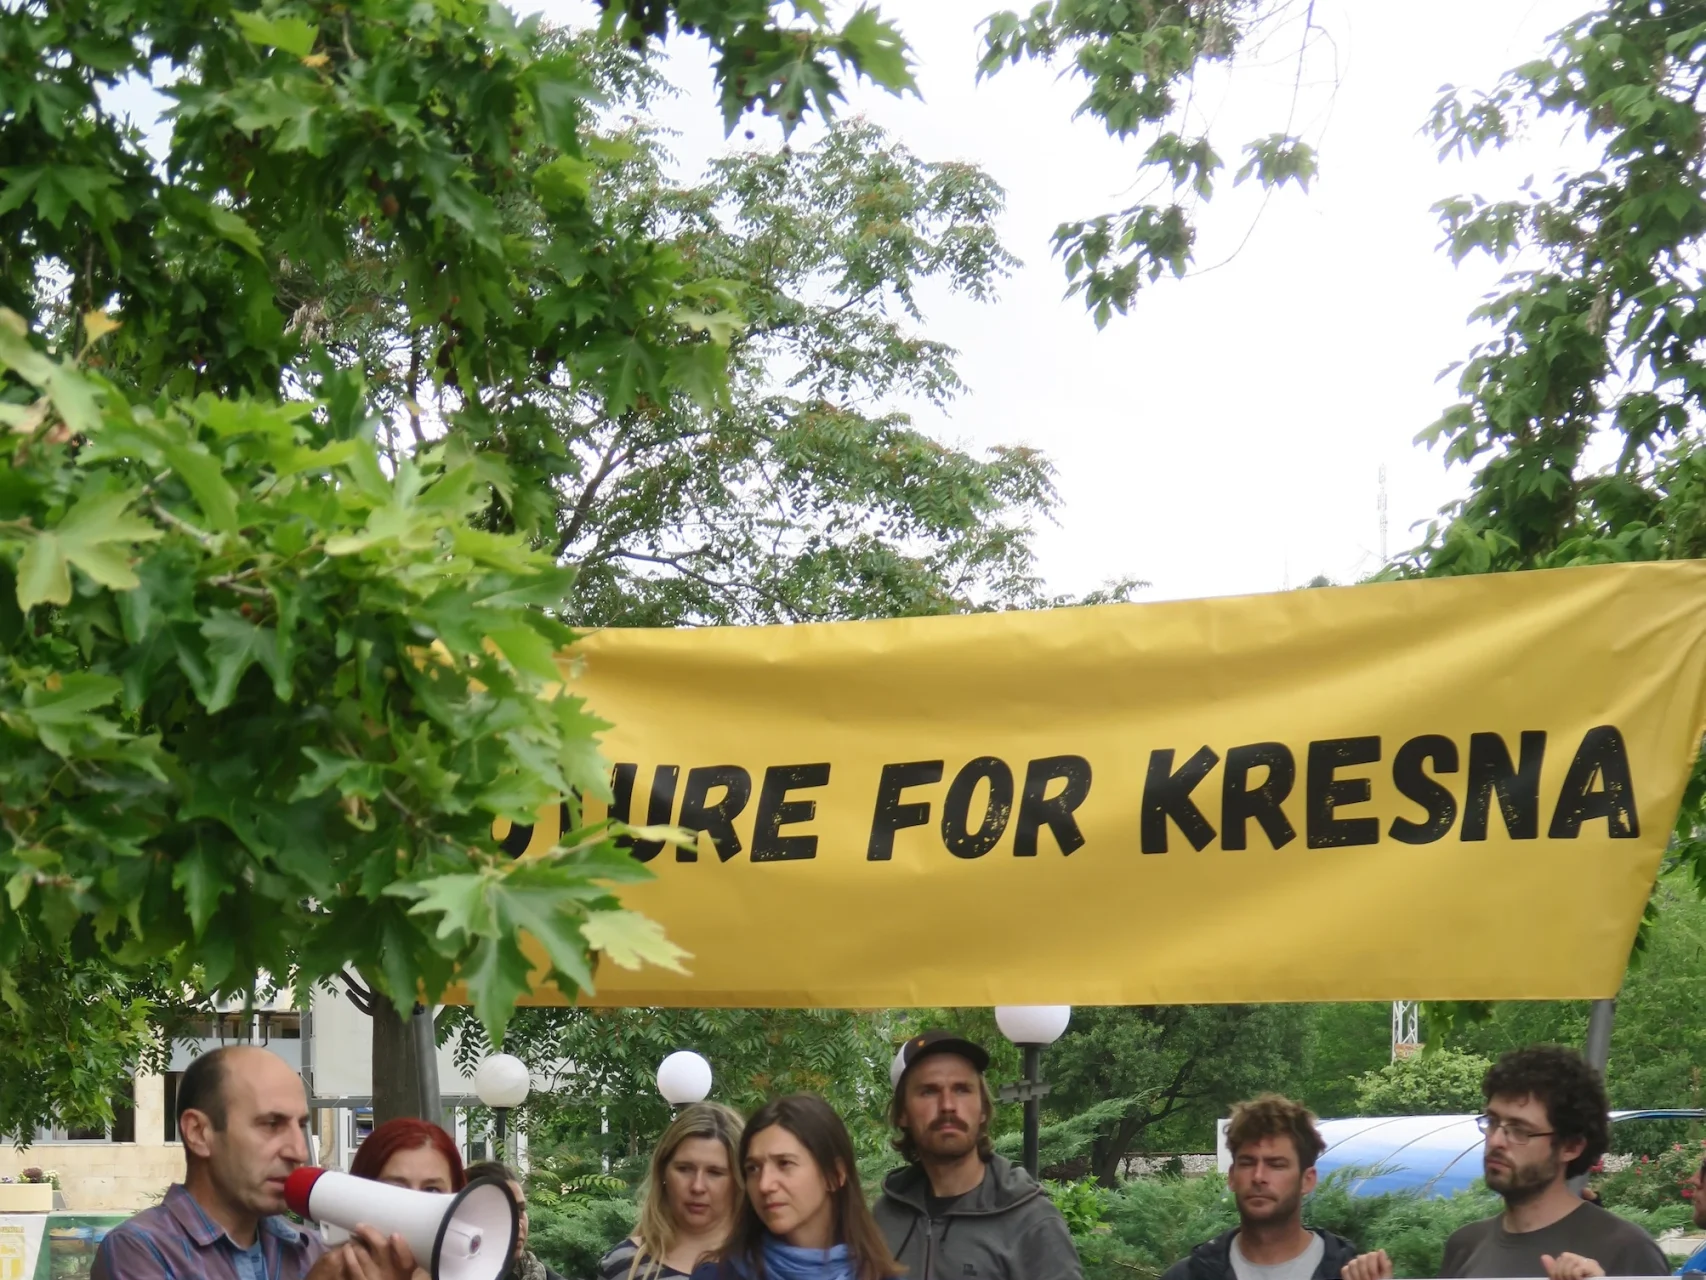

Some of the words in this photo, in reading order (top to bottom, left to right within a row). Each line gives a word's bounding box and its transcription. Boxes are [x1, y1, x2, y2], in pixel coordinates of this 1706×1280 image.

[492, 762, 831, 863] URE
[866, 755, 1092, 861] FOR
[1140, 724, 1640, 855] KRESNA
